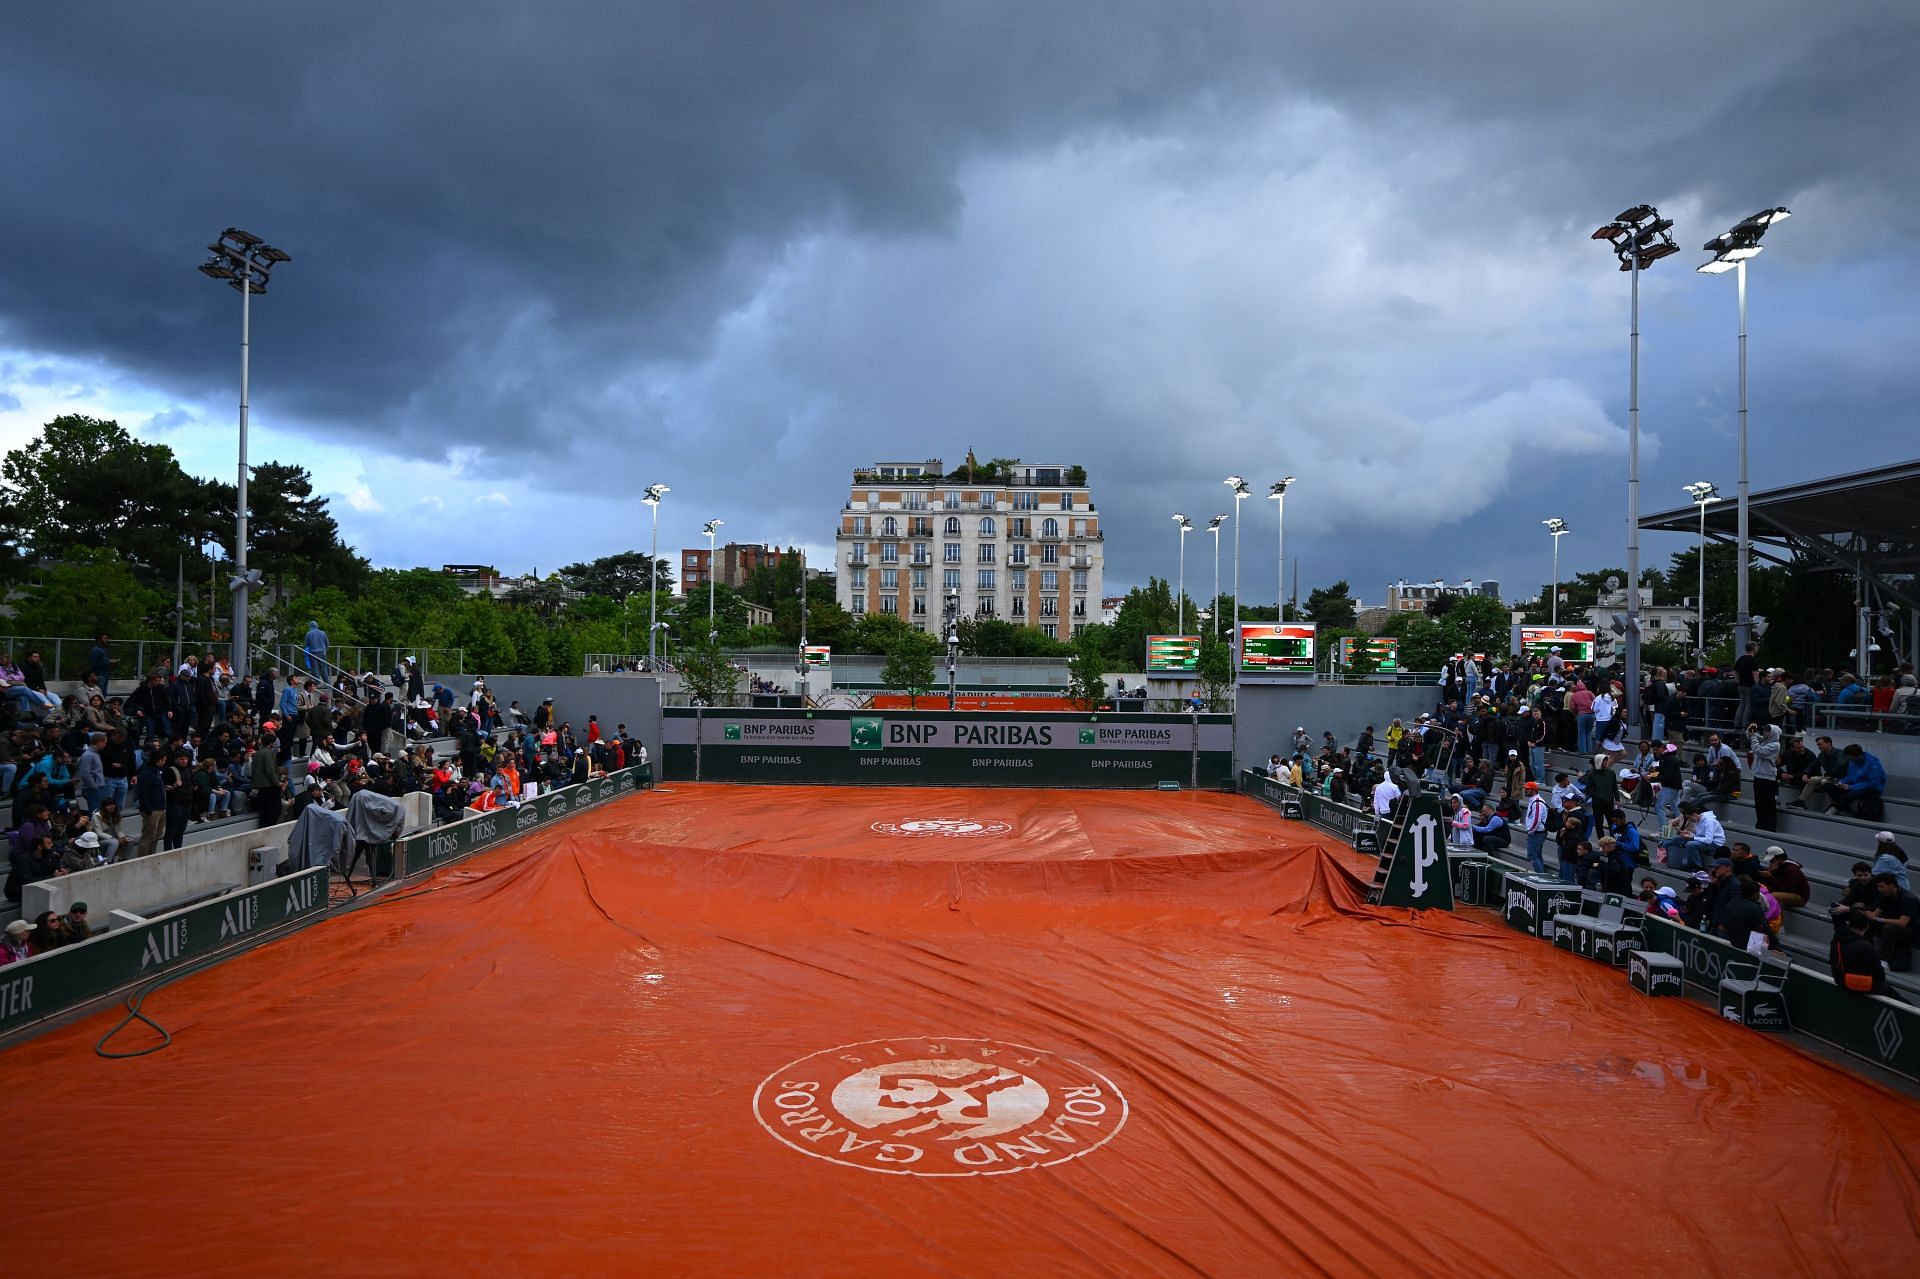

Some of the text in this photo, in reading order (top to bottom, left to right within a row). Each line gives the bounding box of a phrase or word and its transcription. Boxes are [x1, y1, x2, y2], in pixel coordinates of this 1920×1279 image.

[744, 724, 814, 735] BNP PARIBAS
[890, 724, 1052, 746] BNP PARIBAS
[1100, 728, 1170, 740] BNP PARIBAS
[740, 756, 802, 764] BNP PARIBAS
[860, 757, 920, 766] BNP PARIBAS
[972, 758, 1033, 768] BNP PARIBAS
[1091, 760, 1152, 768] BNP PARIBAS
[1320, 804, 1344, 827] Emirates
[470, 819, 496, 842] Infosys
[428, 832, 458, 858] Infosys
[1507, 888, 1534, 920] perrier
[1616, 937, 1642, 958] perrier
[1651, 972, 1681, 990] perrier
[774, 1080, 1106, 1166] ROLAND GARROS
